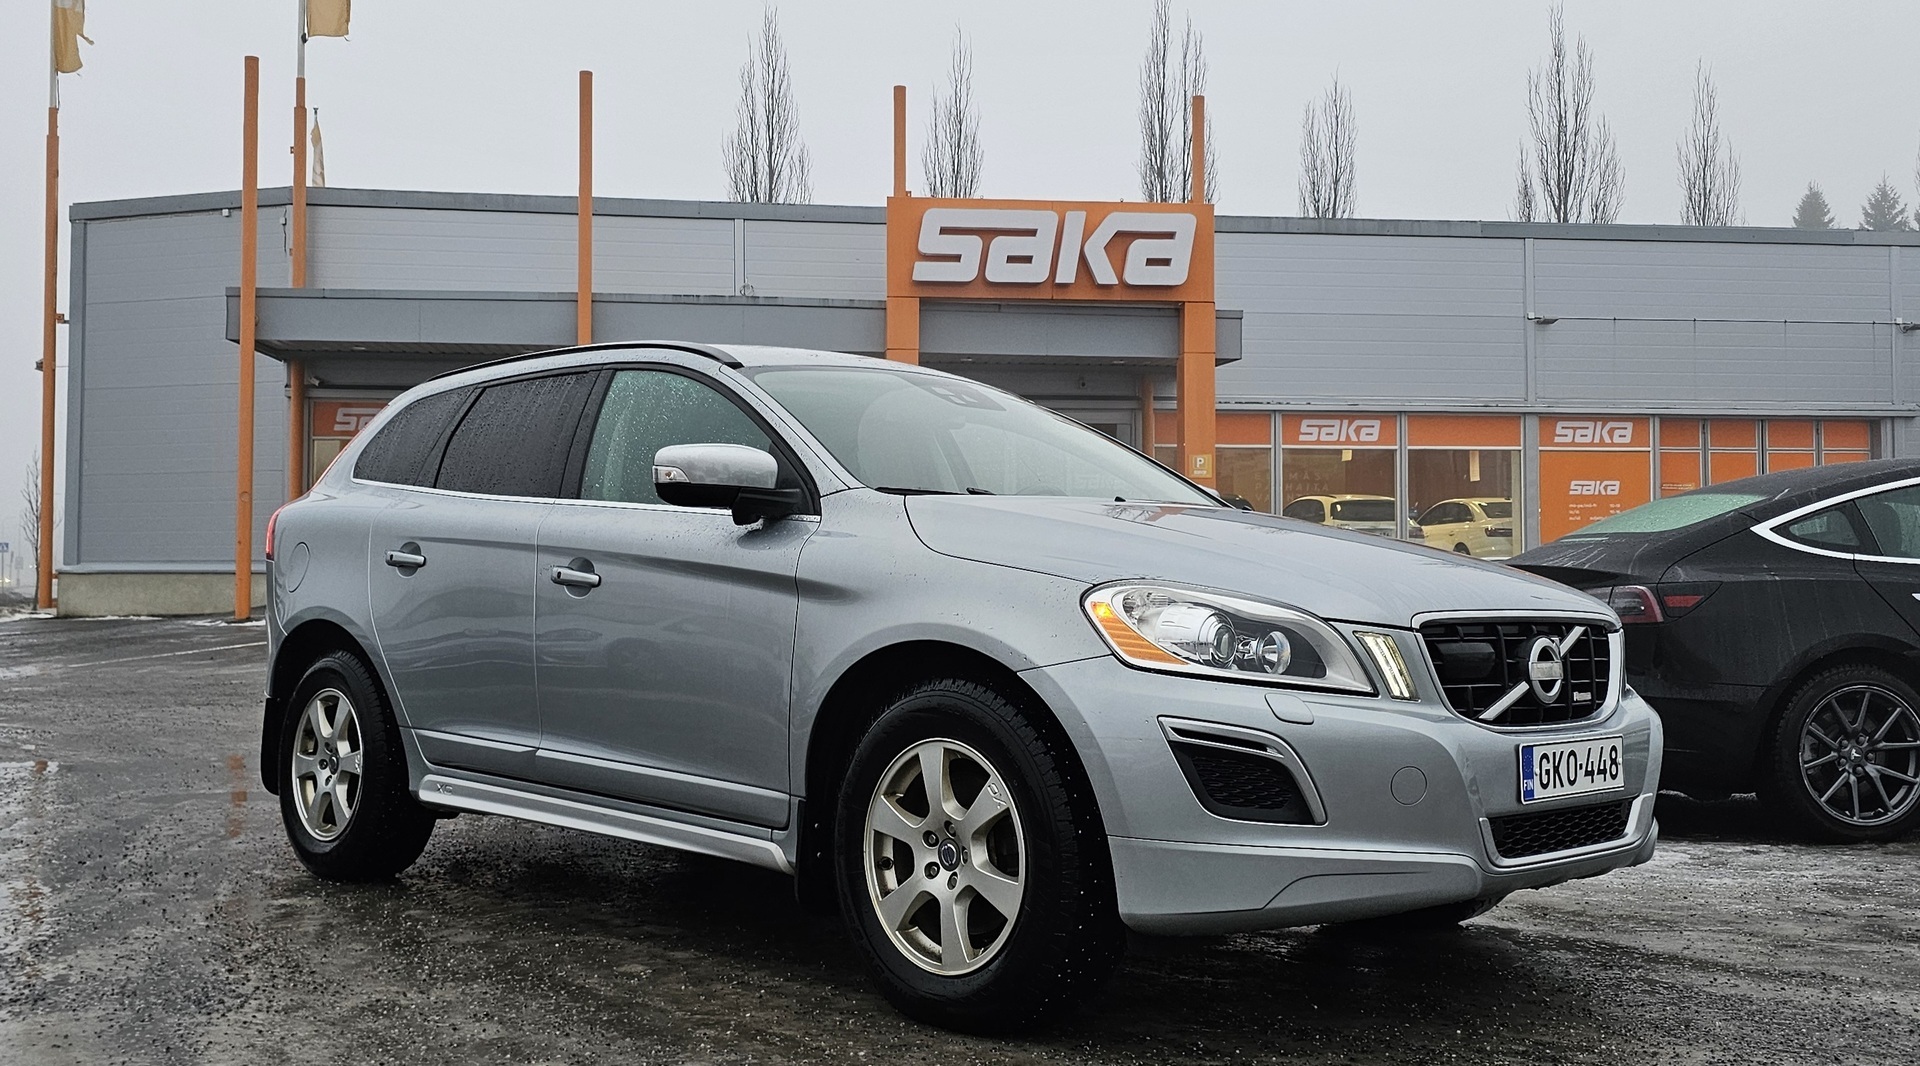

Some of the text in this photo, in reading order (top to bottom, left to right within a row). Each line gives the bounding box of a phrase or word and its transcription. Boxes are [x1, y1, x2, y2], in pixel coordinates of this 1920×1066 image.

[1196, 457, 1205, 468] P
[1539, 744, 1619, 790] GKO-448
[1524, 779, 1534, 791] FIN
